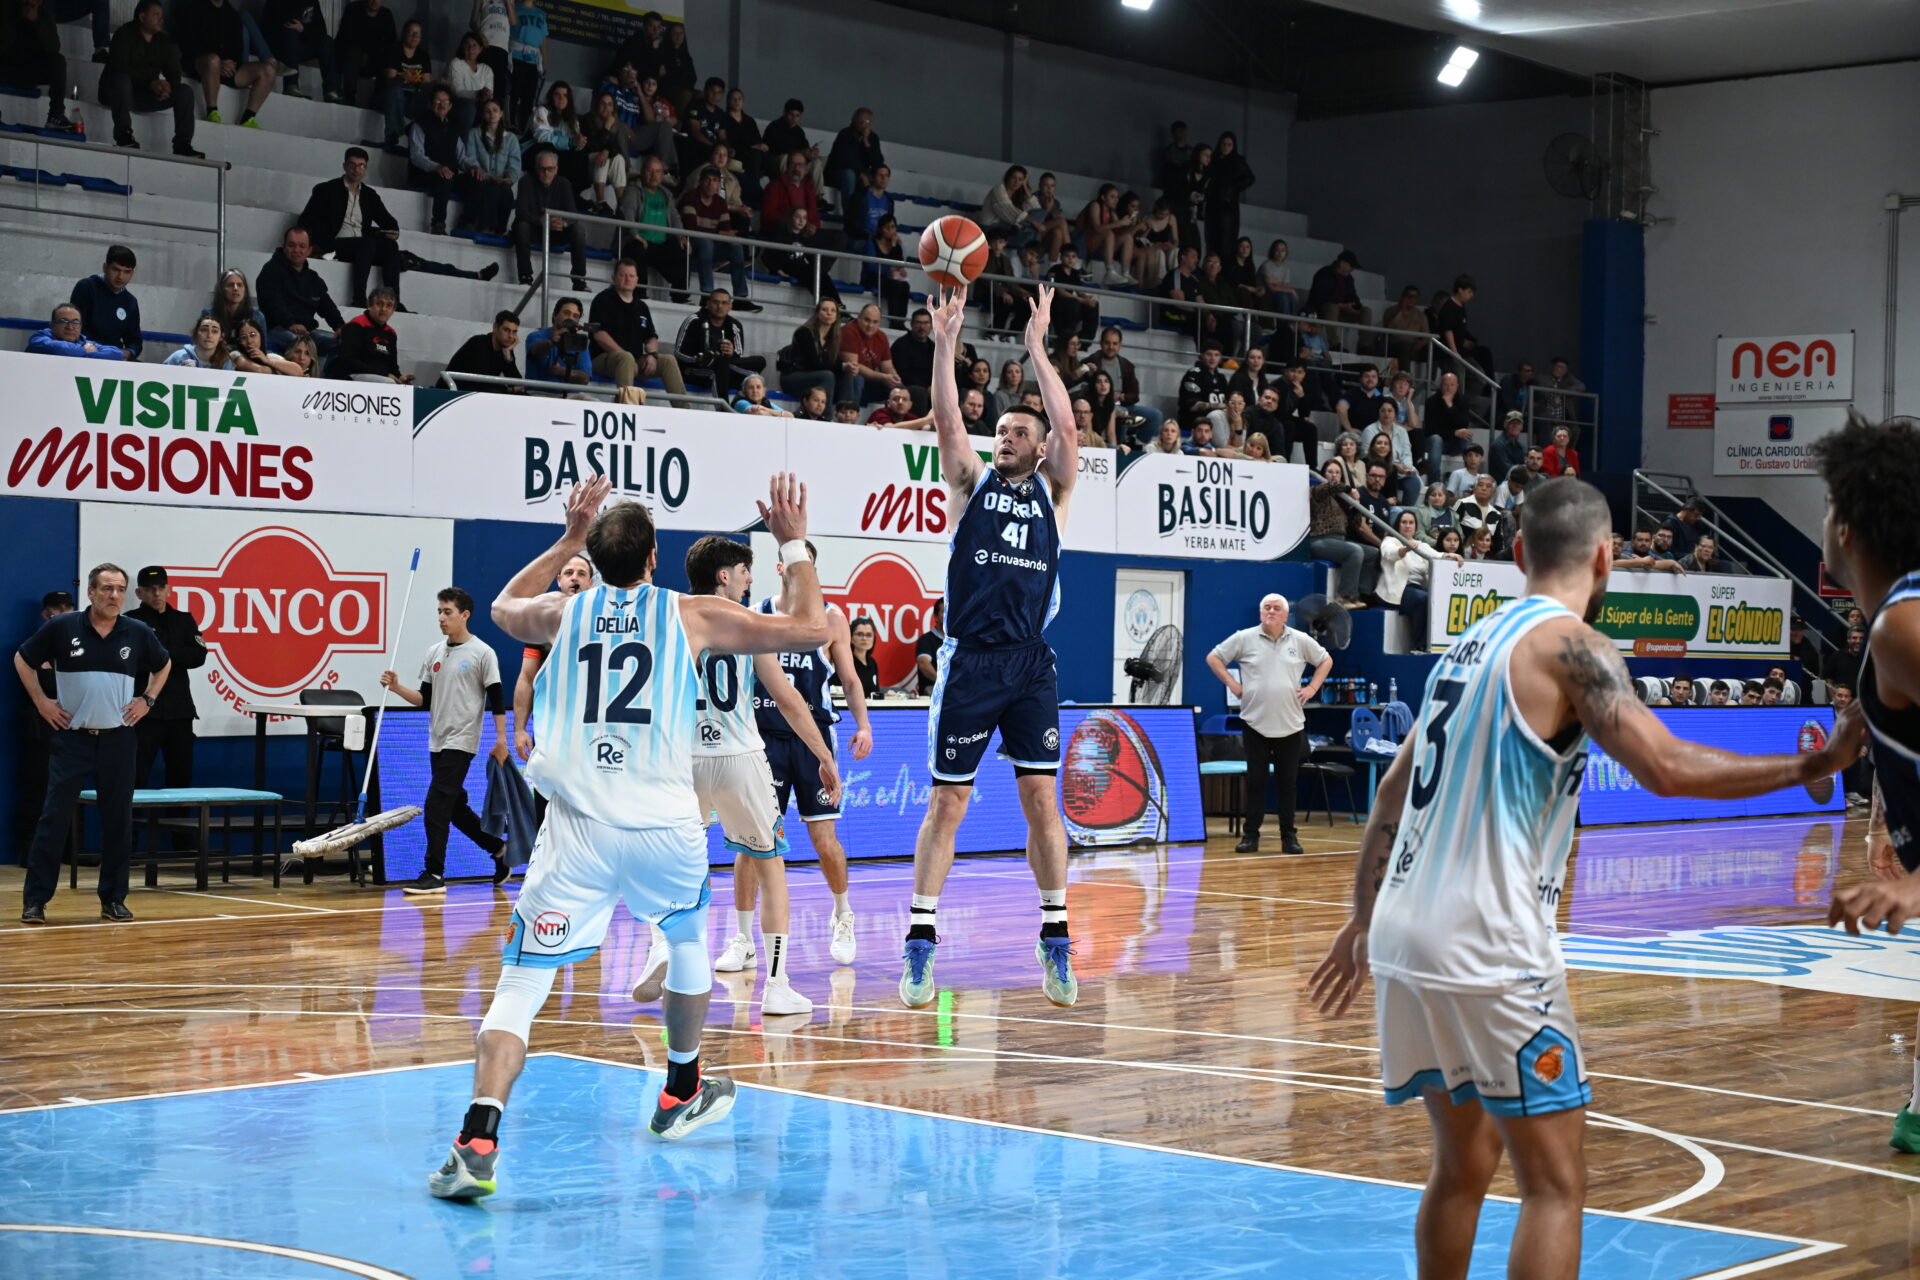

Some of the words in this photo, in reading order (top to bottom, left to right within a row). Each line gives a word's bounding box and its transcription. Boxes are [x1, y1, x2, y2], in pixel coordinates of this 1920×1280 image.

[1731, 381, 1835, 393] INGENIERIA
[75, 376, 259, 436] VISITÁ
[302, 390, 401, 417] MISIONES
[304, 412, 399, 426] GOBIERNO
[583, 409, 636, 441] DON
[7, 426, 314, 501] MISIONES
[1727, 444, 1763, 458] CLÍNICA
[525, 437, 690, 508] BASILIO
[1197, 460, 1233, 485] DON
[1740, 459, 1753, 470] Dr.
[1755, 459, 1791, 470] Gustavo
[1158, 483, 1270, 540] BASILIO
[1001, 521, 1029, 550] 41
[1184, 536, 1216, 549] YERBA
[1220, 538, 1246, 551] MATE
[991, 552, 1047, 572] Envasando
[1453, 569, 1483, 588] SÚPER
[1711, 586, 1736, 600] SÚPER
[172, 586, 370, 636] DINCO
[596, 614, 640, 633] DELÍA
[1446, 593, 1468, 635] EL
[1606, 606, 1637, 629] Súper
[1639, 607, 1652, 625] de
[1654, 608, 1664, 625] la
[1665, 609, 1695, 627] Gente
[1707, 605, 1724, 643] EL
[1725, 600, 1784, 645] CÓNDOR
[578, 641, 653, 725] 12
[1412, 679, 1468, 811] 3
[537, 922, 566, 936] NTH
